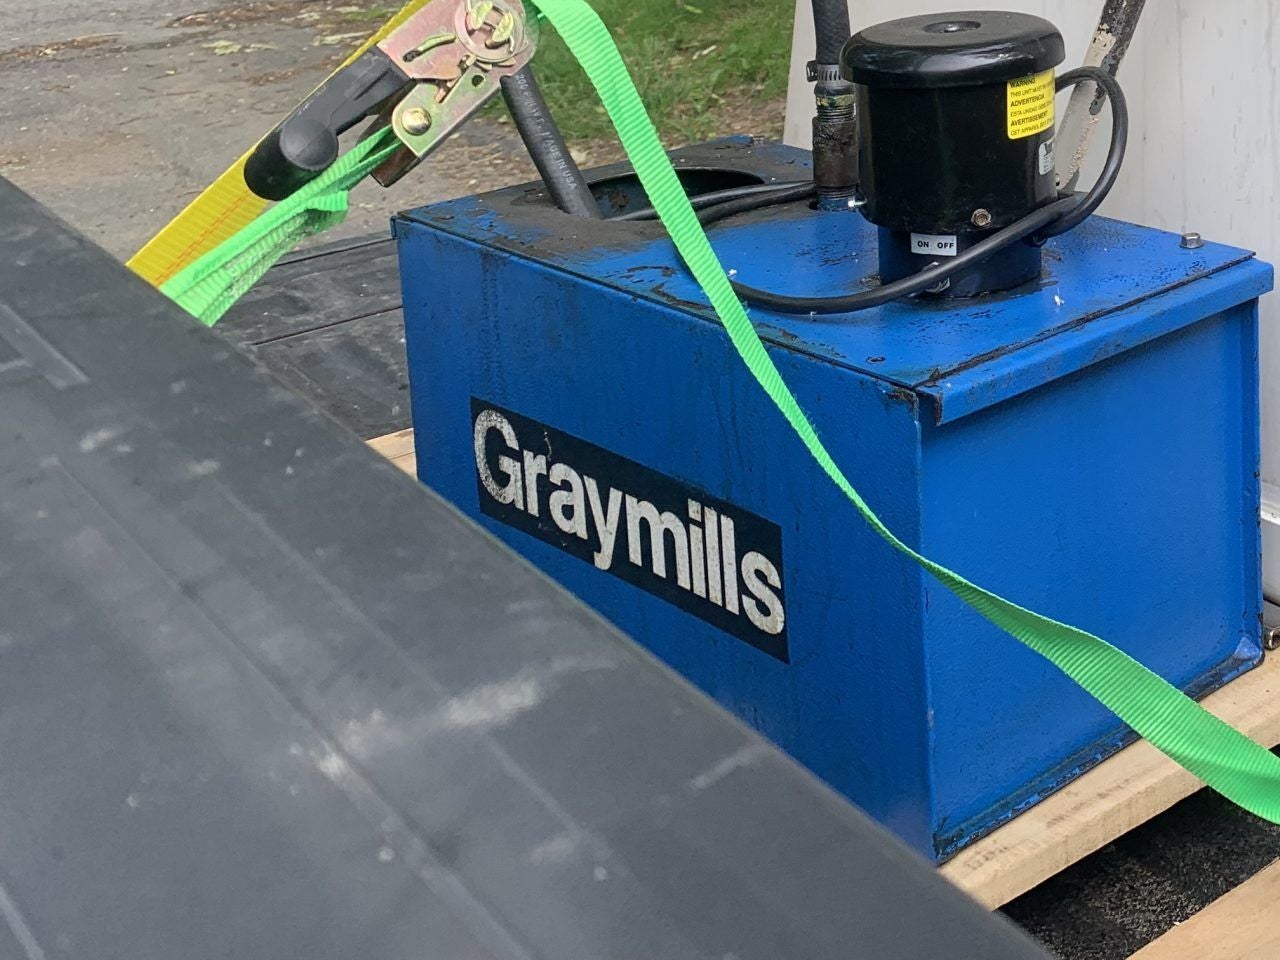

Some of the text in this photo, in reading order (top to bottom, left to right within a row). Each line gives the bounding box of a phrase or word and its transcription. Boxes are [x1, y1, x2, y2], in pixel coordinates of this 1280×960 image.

[1009, 78, 1036, 88] WARNING
[562, 169, 578, 190] USA
[917, 240, 930, 248] ON
[474, 409, 785, 634] Graymills
